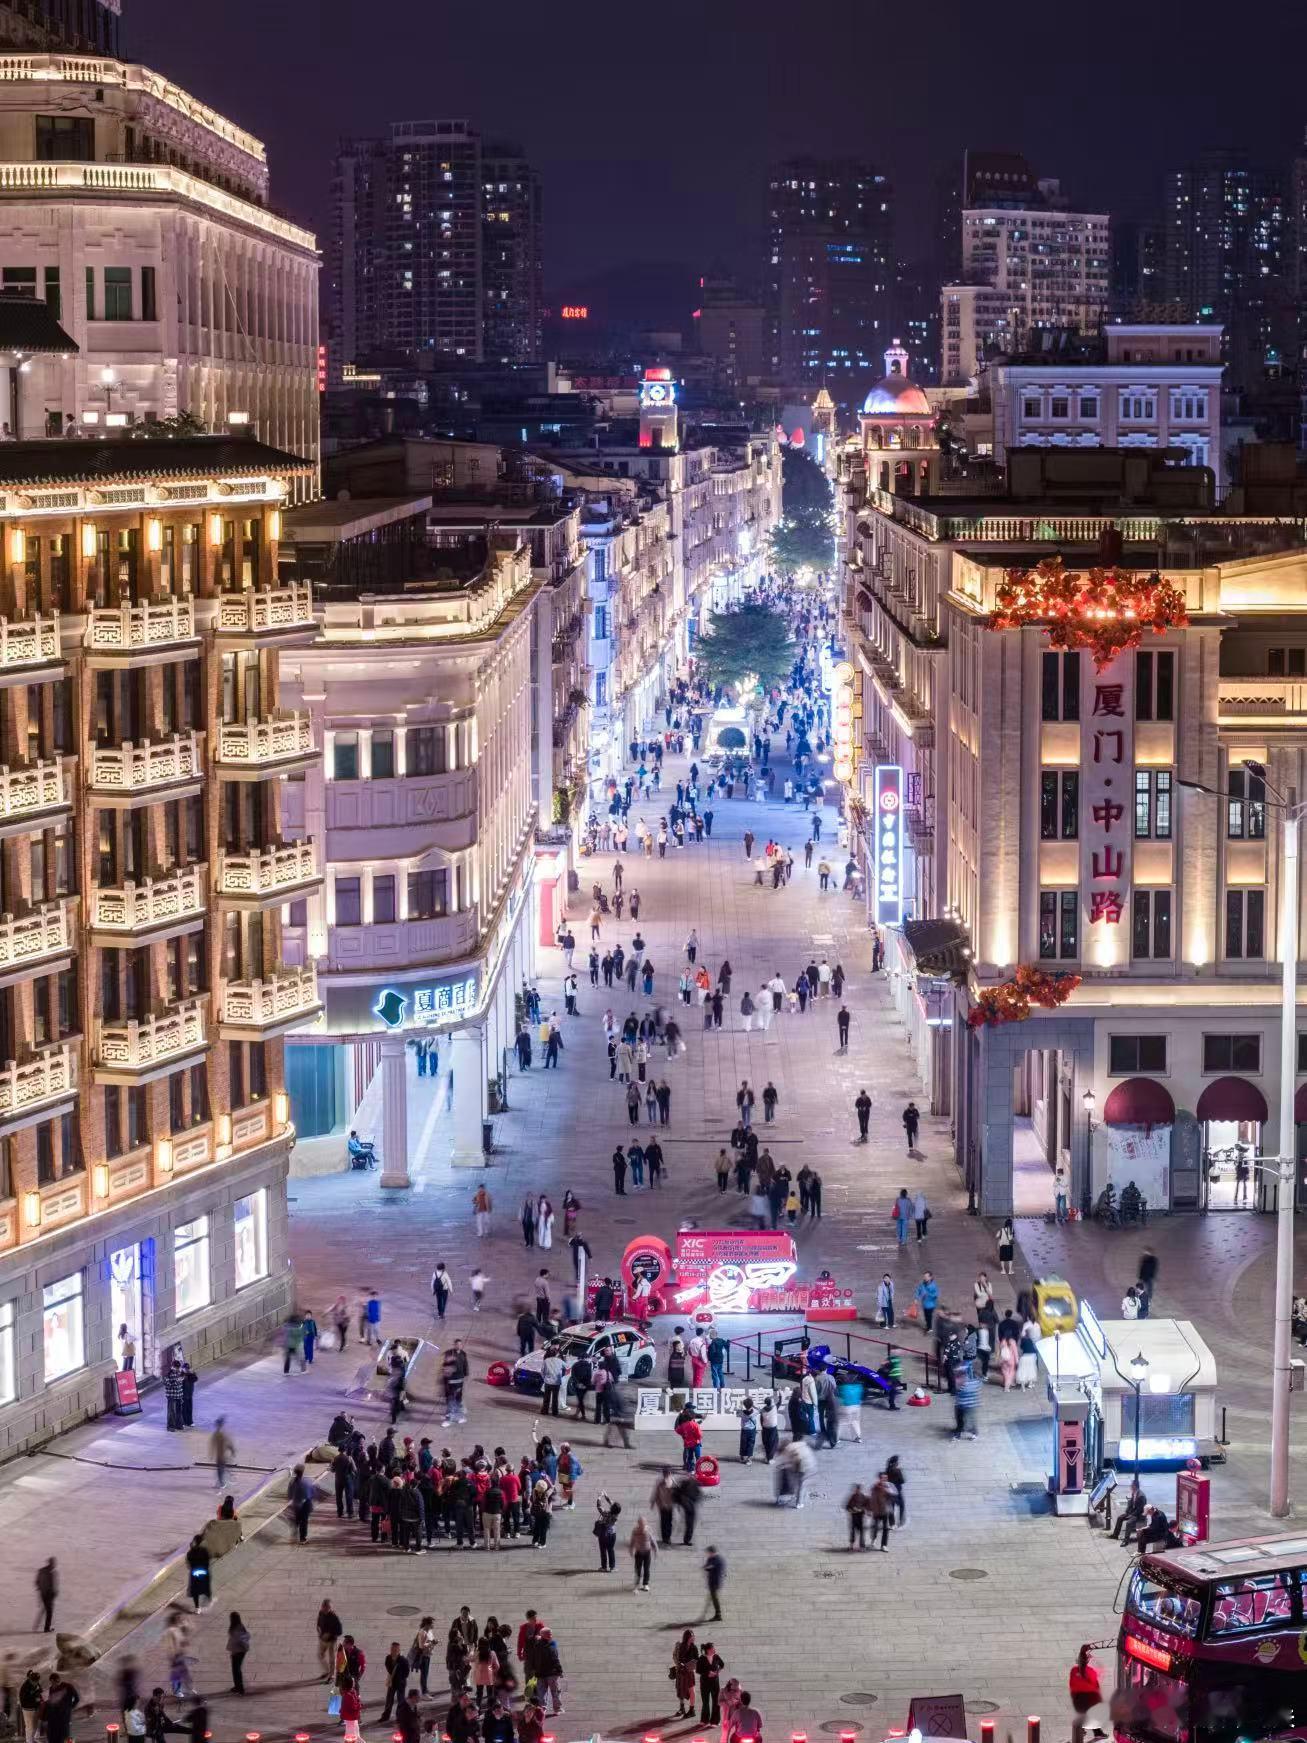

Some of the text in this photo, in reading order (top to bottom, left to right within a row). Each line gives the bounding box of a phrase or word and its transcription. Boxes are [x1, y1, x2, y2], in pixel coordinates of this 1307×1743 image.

[1090, 684, 1125, 924] 厦门·中山路
[682, 1239, 705, 1248] XIC
